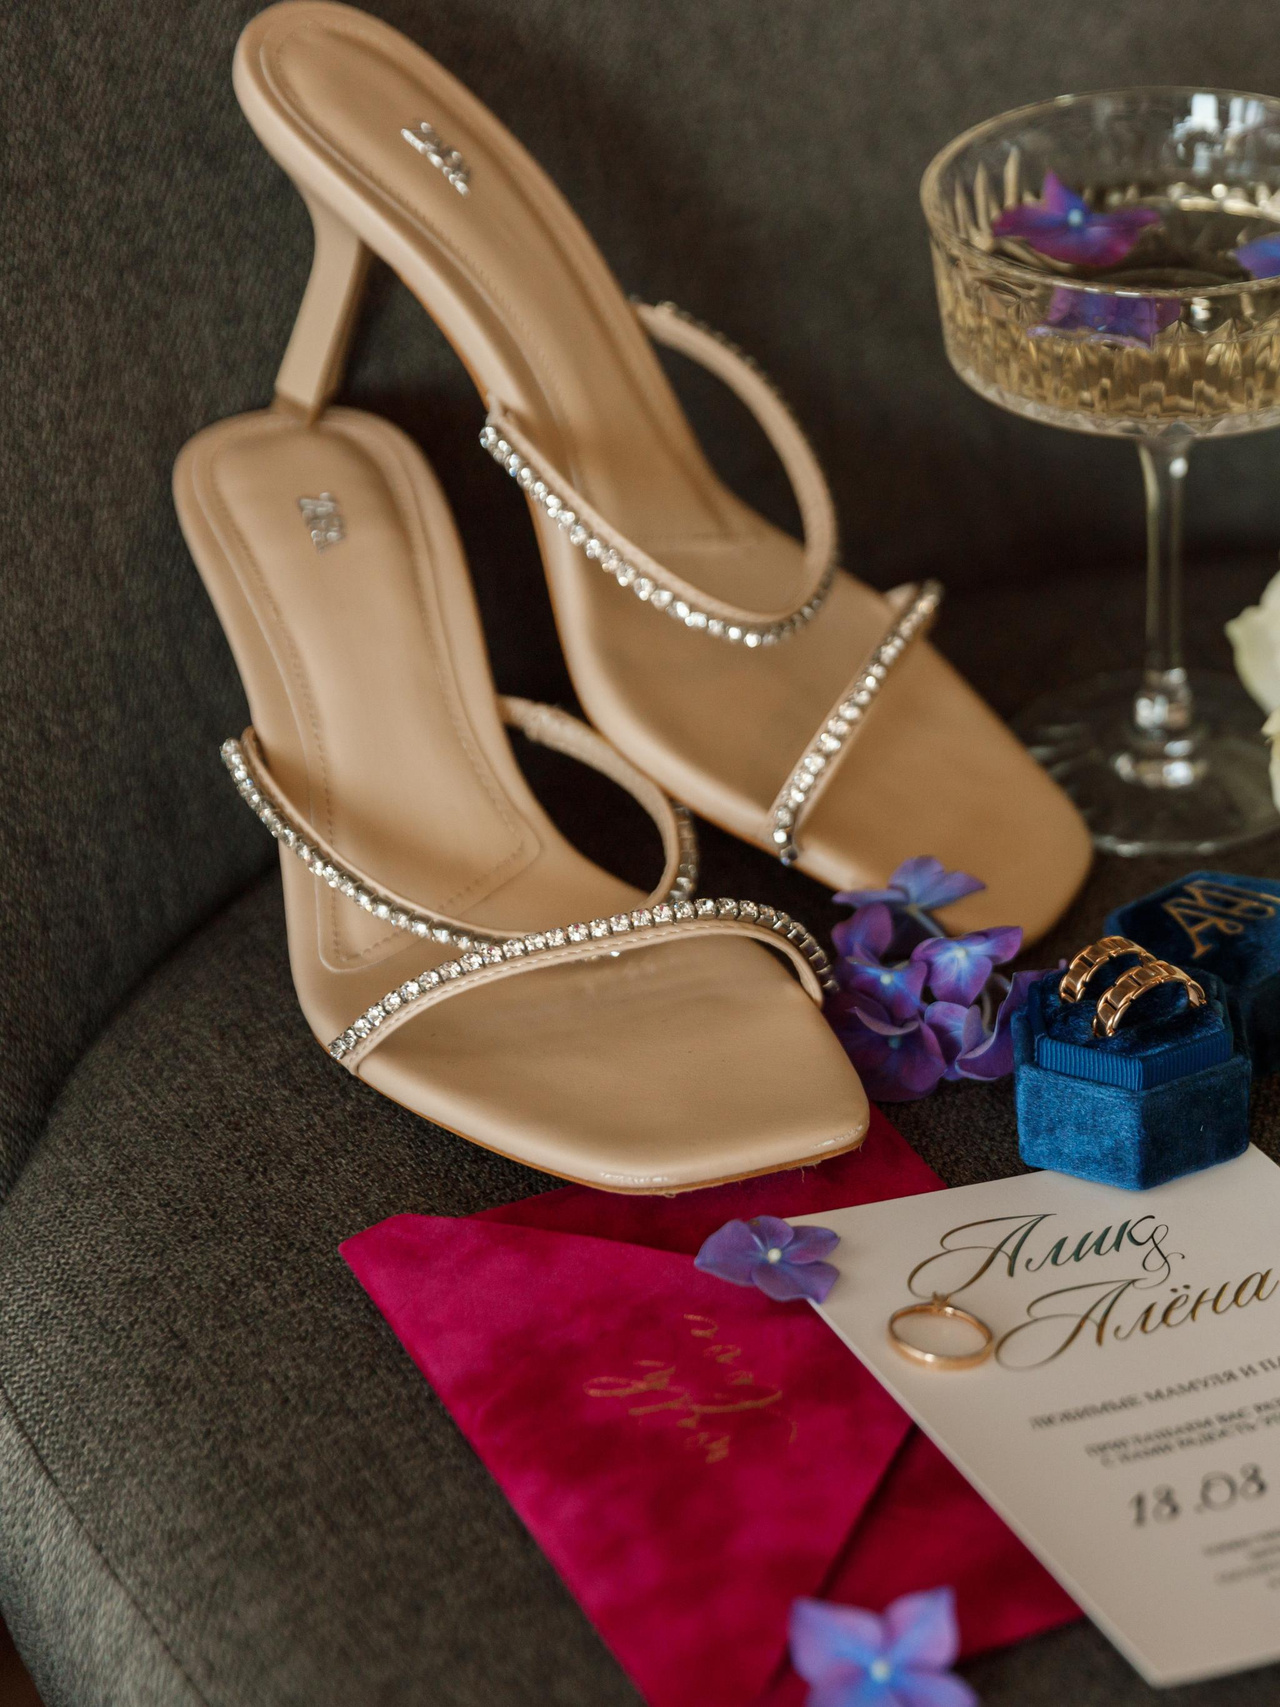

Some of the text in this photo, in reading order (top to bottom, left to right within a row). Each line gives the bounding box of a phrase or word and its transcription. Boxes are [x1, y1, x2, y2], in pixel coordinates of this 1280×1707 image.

[907, 1213, 1185, 1300] Алик &
[995, 1268, 1279, 1372] Алёна
[1144, 1369, 1238, 1402] МАМУЛЯ
[1238, 1363, 1258, 1379] И
